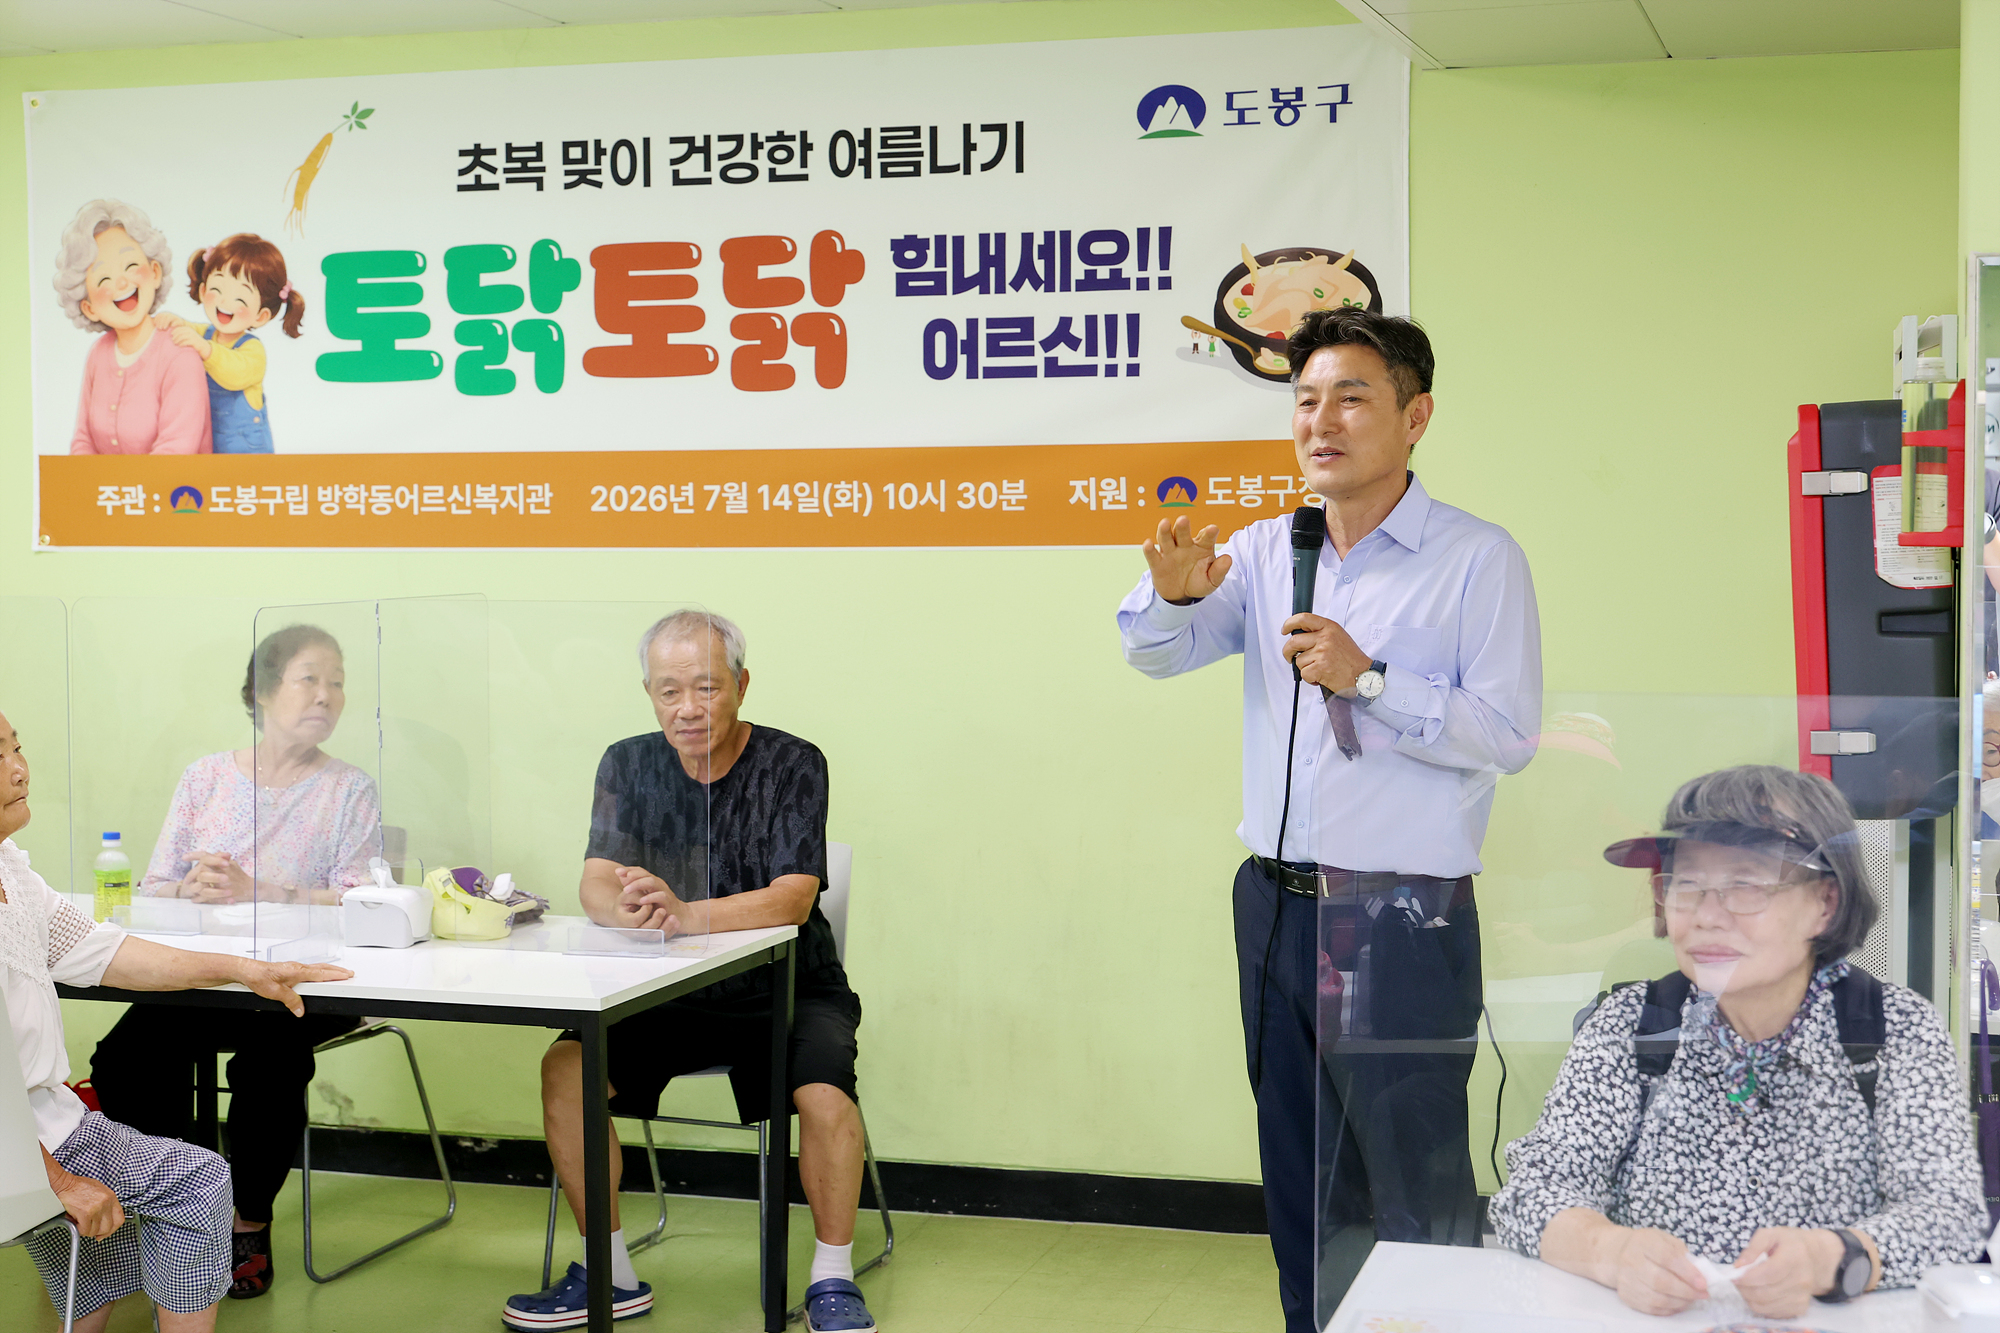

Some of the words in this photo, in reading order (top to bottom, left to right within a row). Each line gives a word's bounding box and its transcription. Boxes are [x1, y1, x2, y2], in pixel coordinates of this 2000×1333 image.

[1222, 83, 1354, 128] 도봉구
[456, 140, 547, 193] 초복
[561, 136, 652, 191] 맞이
[668, 129, 814, 187] 건강한
[828, 120, 1025, 180] 여름나기
[889, 225, 1173, 298] 힘내세요!!
[315, 229, 866, 397] 토닭토닭
[922, 312, 1141, 381] 어르신!!
[208, 483, 309, 516] 도봉구립
[317, 482, 554, 516] 방학동어르신복지관
[590, 481, 695, 515] 2026년
[703, 481, 749, 514] 7월
[757, 480, 874, 518] 14일(화)
[882, 479, 946, 513] 10시
[956, 479, 1028, 512] 30분
